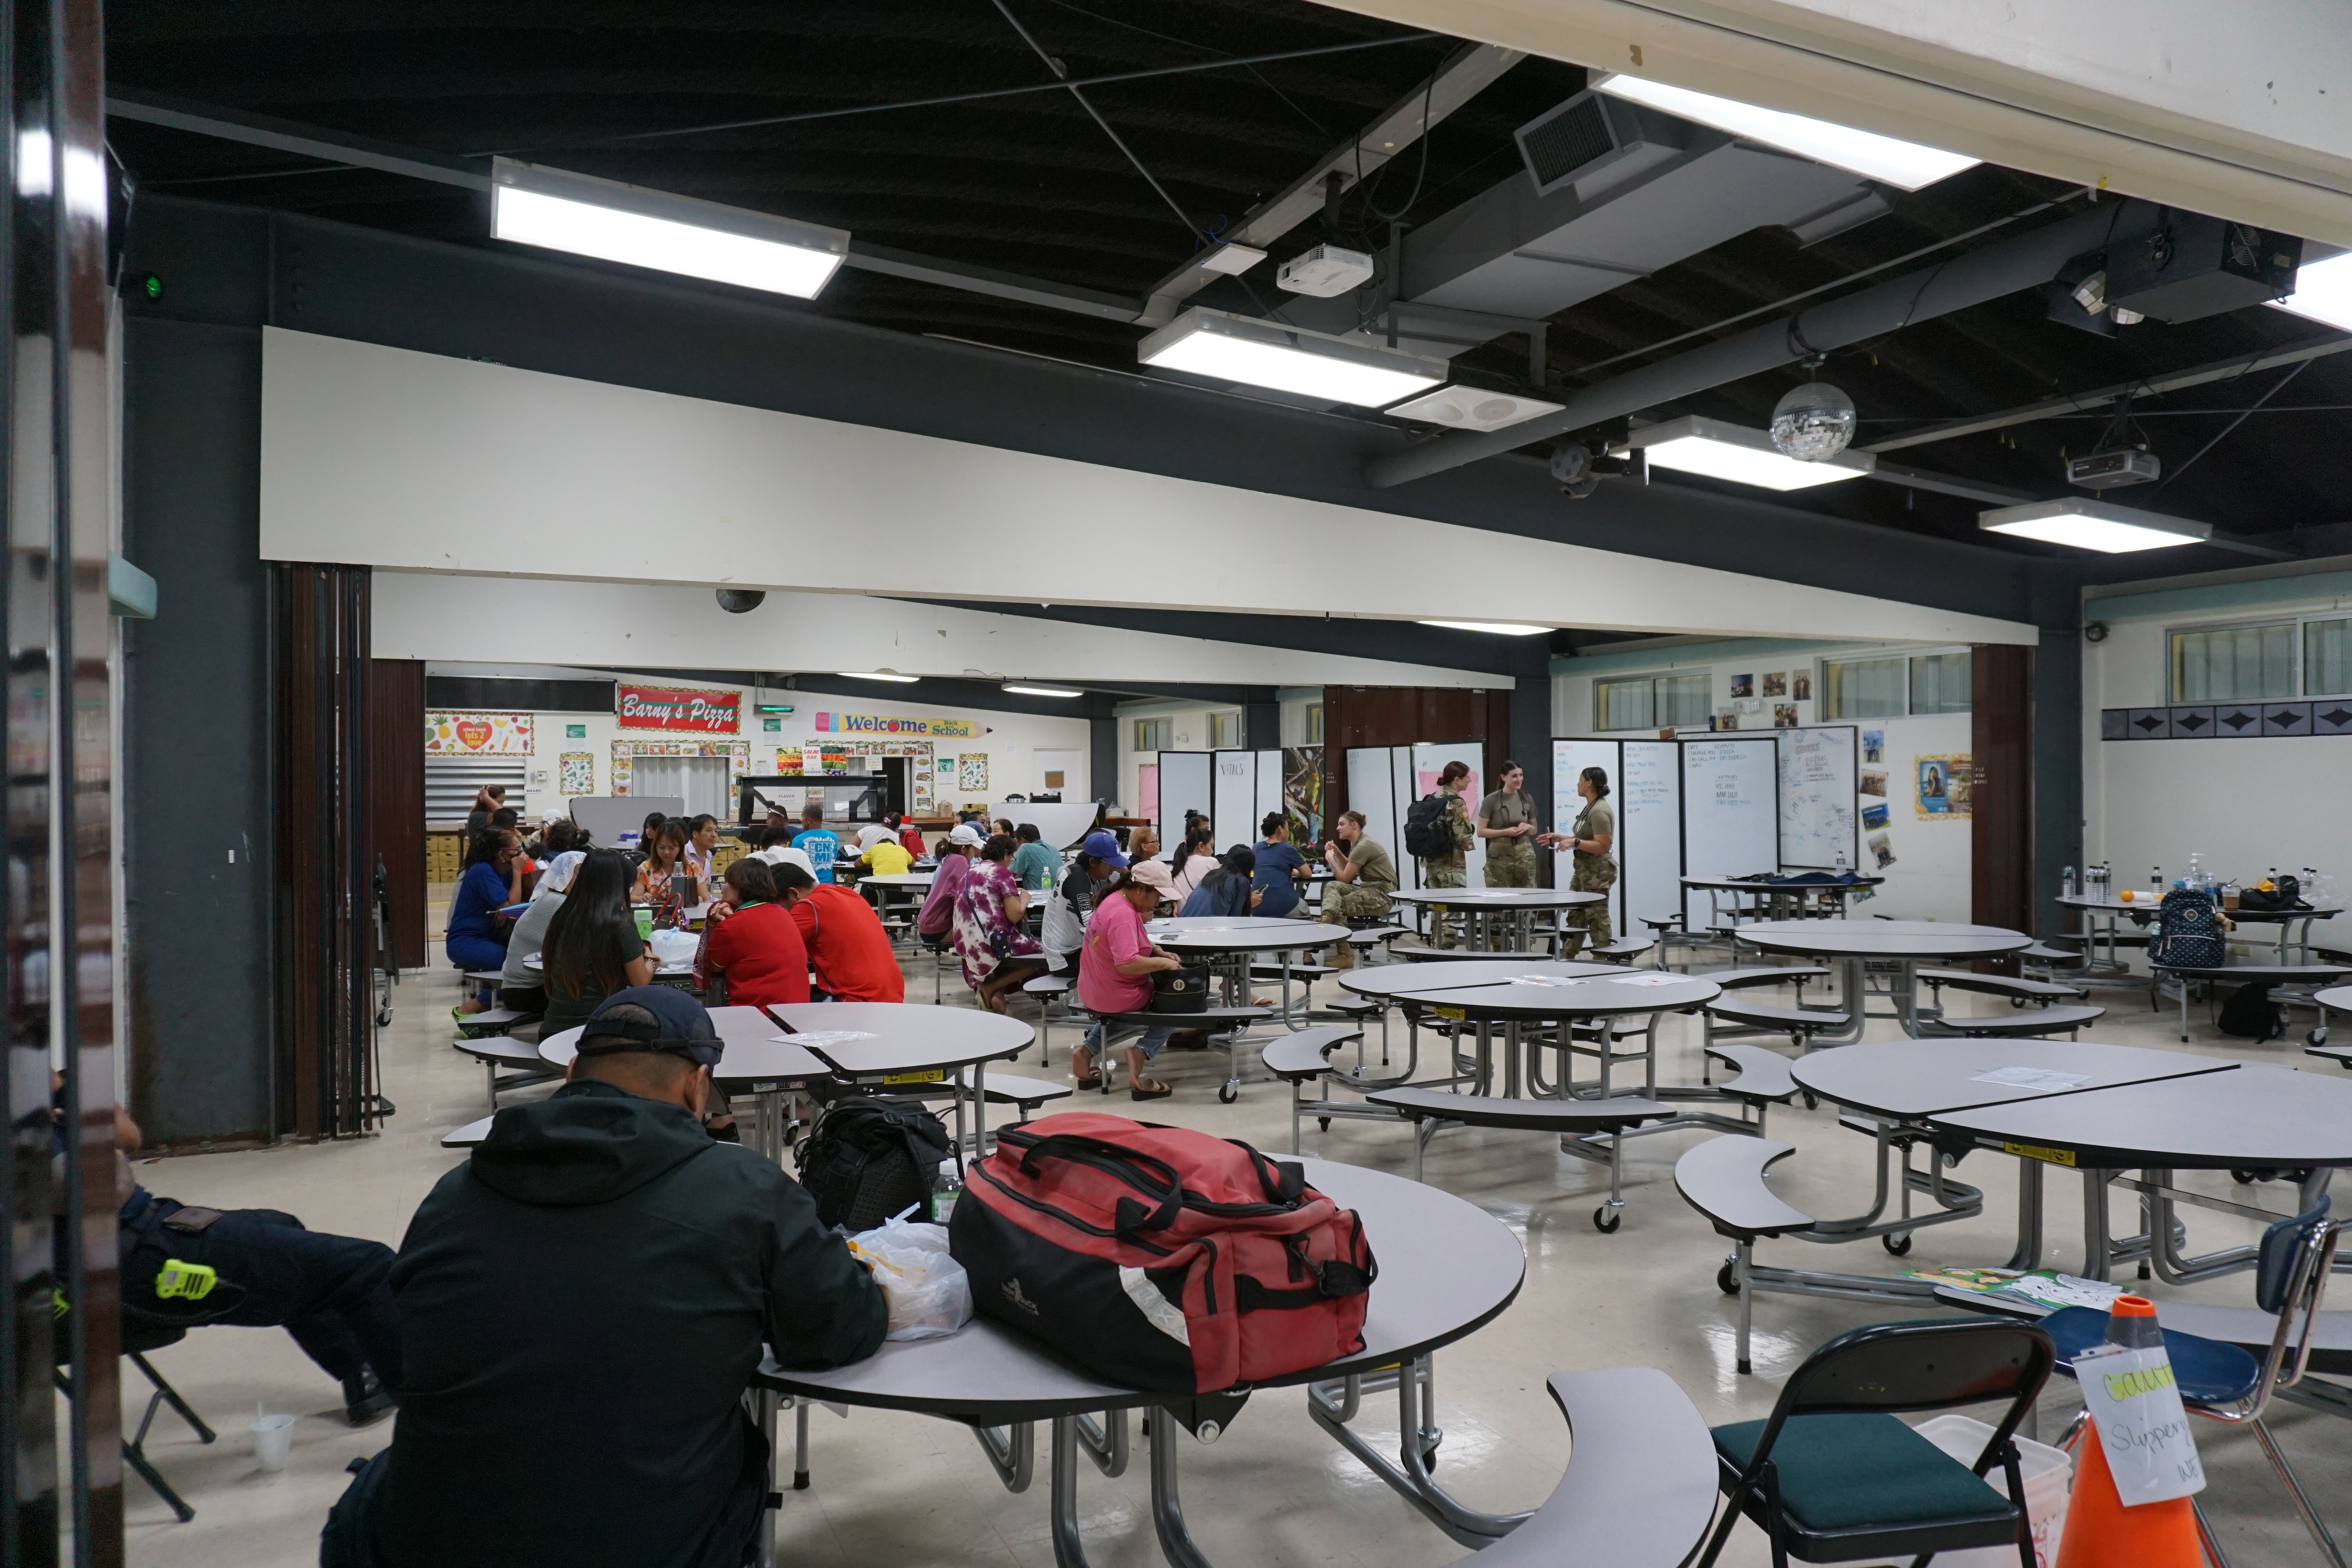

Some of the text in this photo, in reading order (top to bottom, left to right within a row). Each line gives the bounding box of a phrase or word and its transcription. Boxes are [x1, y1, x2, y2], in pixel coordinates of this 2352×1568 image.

[623, 694, 733, 729] Barny's Pizza
[845, 715, 927, 733] Welcome
[932, 725, 968, 736] School
[1806, 756, 1828, 765] DFEMS
[1220, 763, 1243, 776] VITALS
[815, 843, 830, 853] CN
[814, 853, 830, 862] MI
